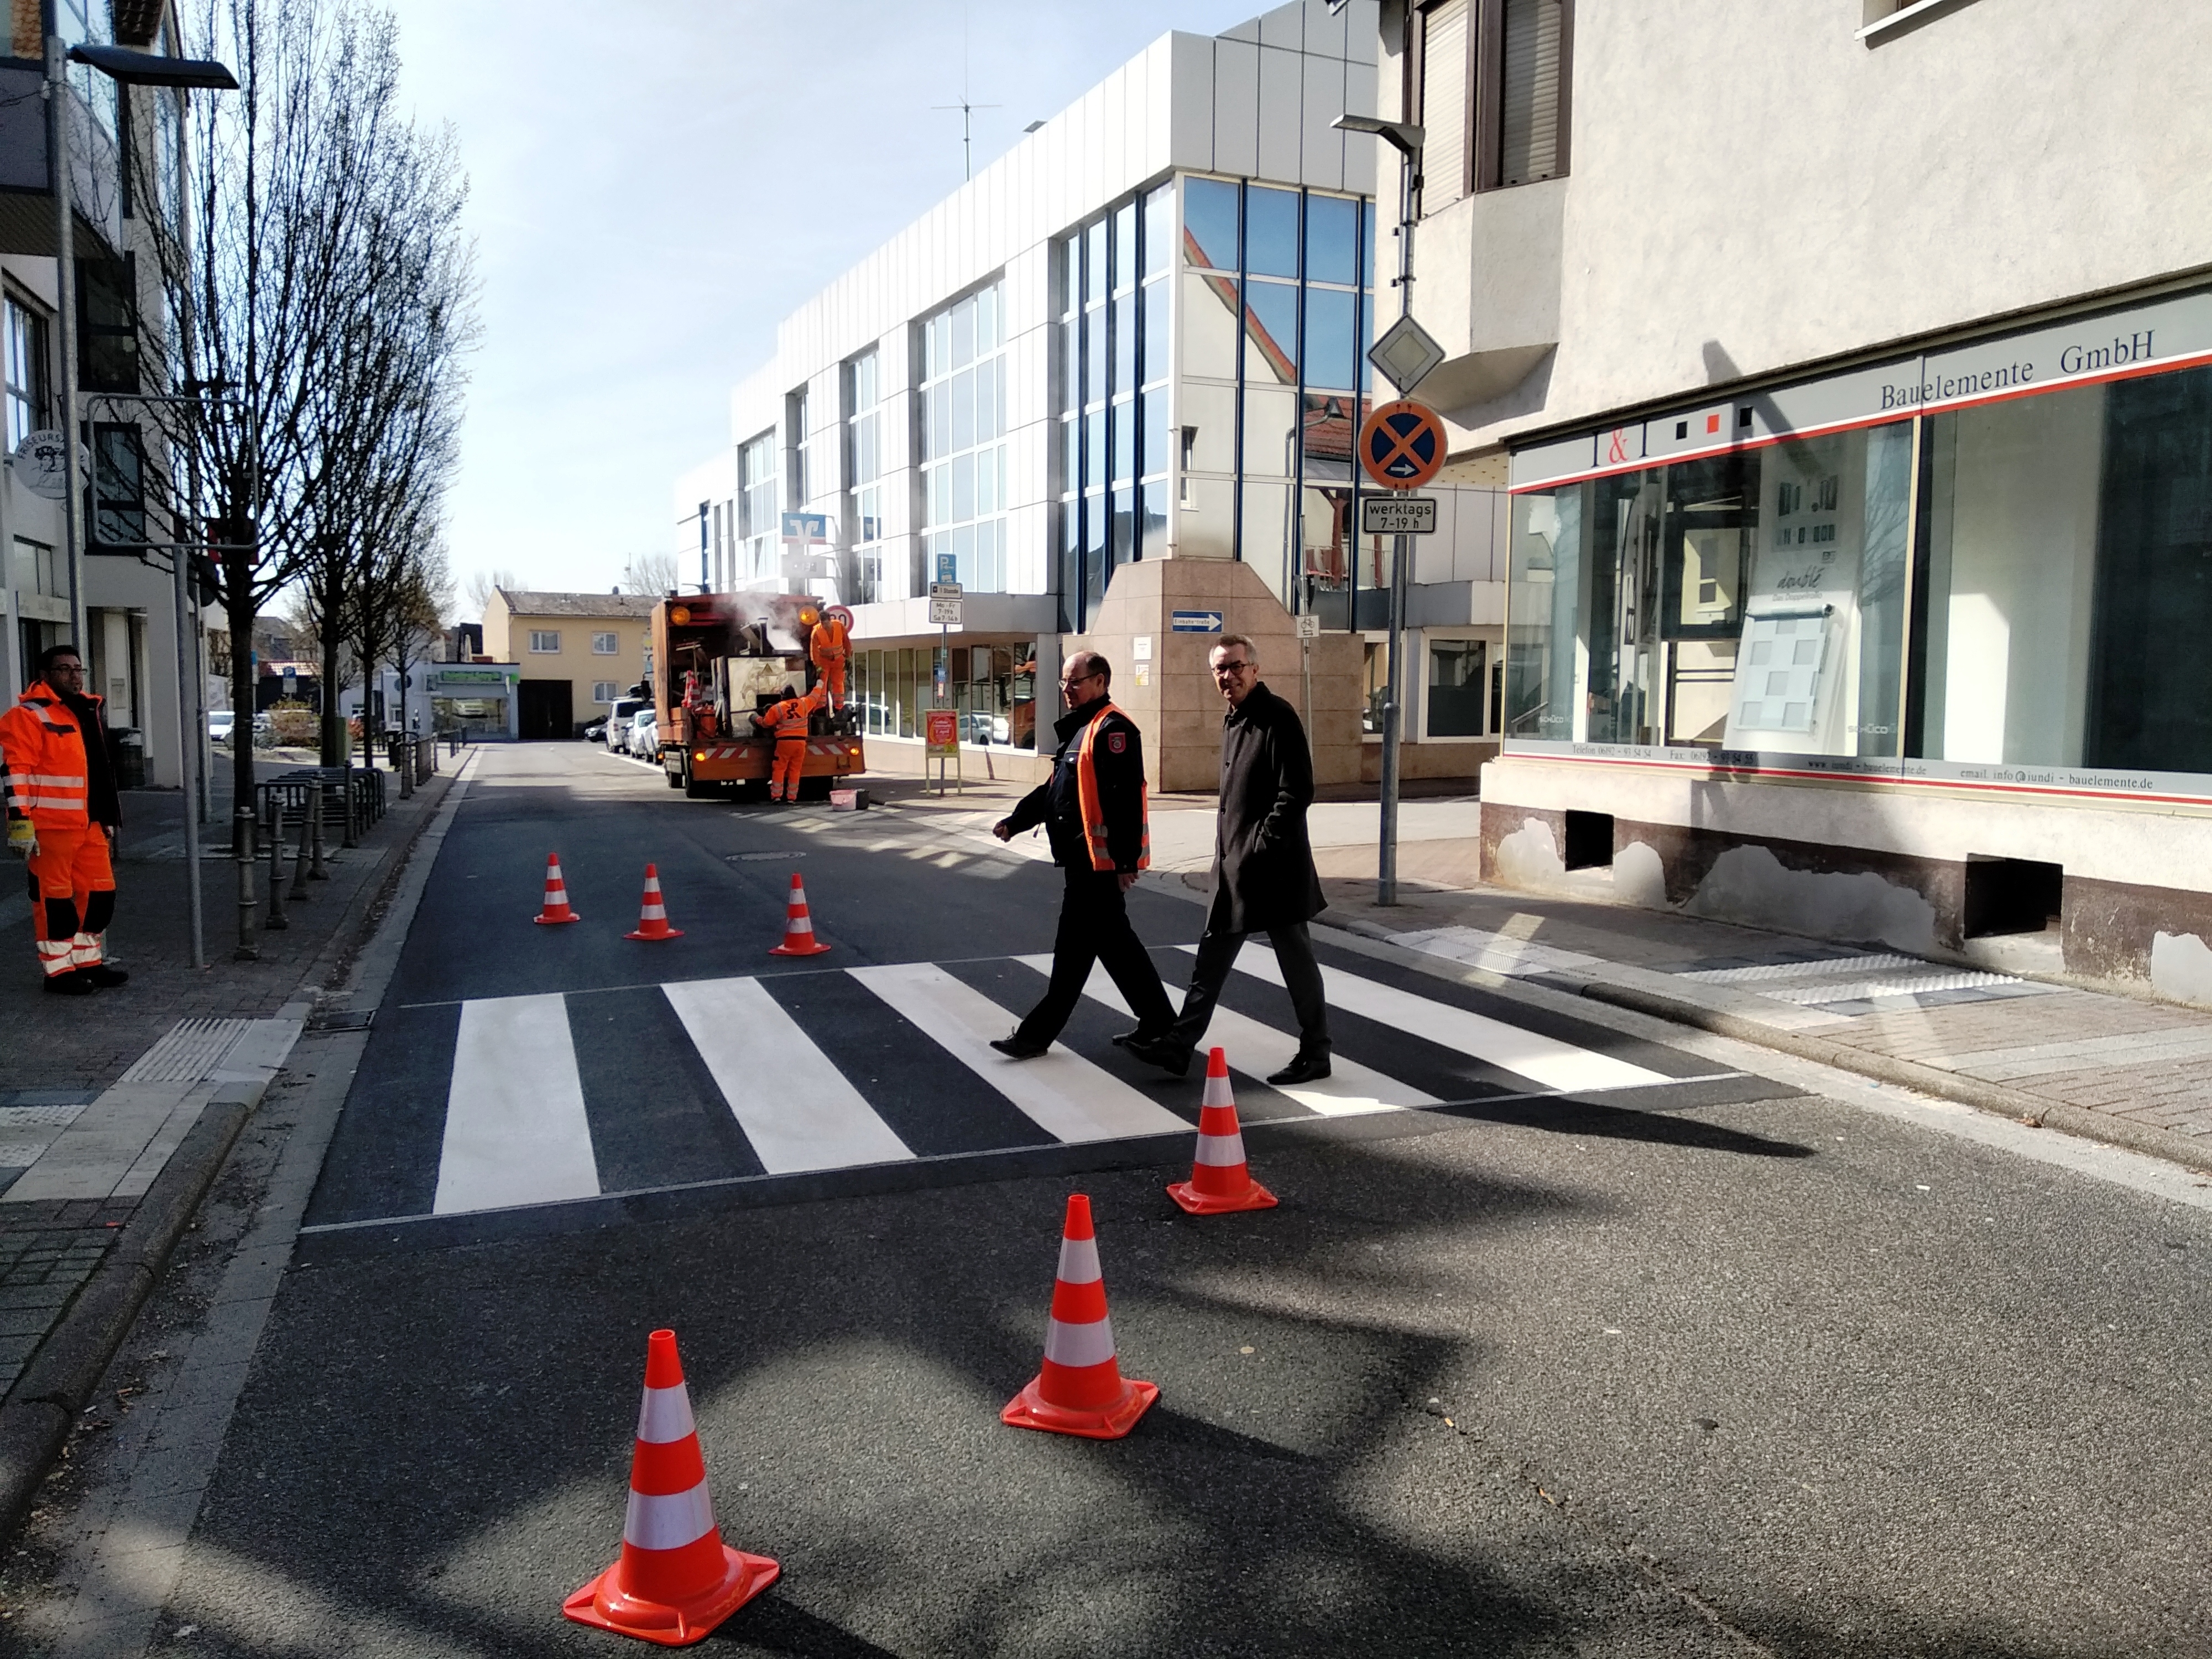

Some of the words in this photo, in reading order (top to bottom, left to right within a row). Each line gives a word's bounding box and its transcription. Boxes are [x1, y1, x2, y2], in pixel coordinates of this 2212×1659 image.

[1881, 359, 2034, 410] Bauelemente
[2060, 329, 2155, 374] GmbH
[1609, 425, 1628, 463] &
[1369, 503, 1431, 518] werktags
[1381, 517, 1408, 529] 7-19
[1413, 518, 1419, 529] h
[1573, 744, 1596, 754] Telefon
[2069, 774, 2153, 789] bauelemente.de
